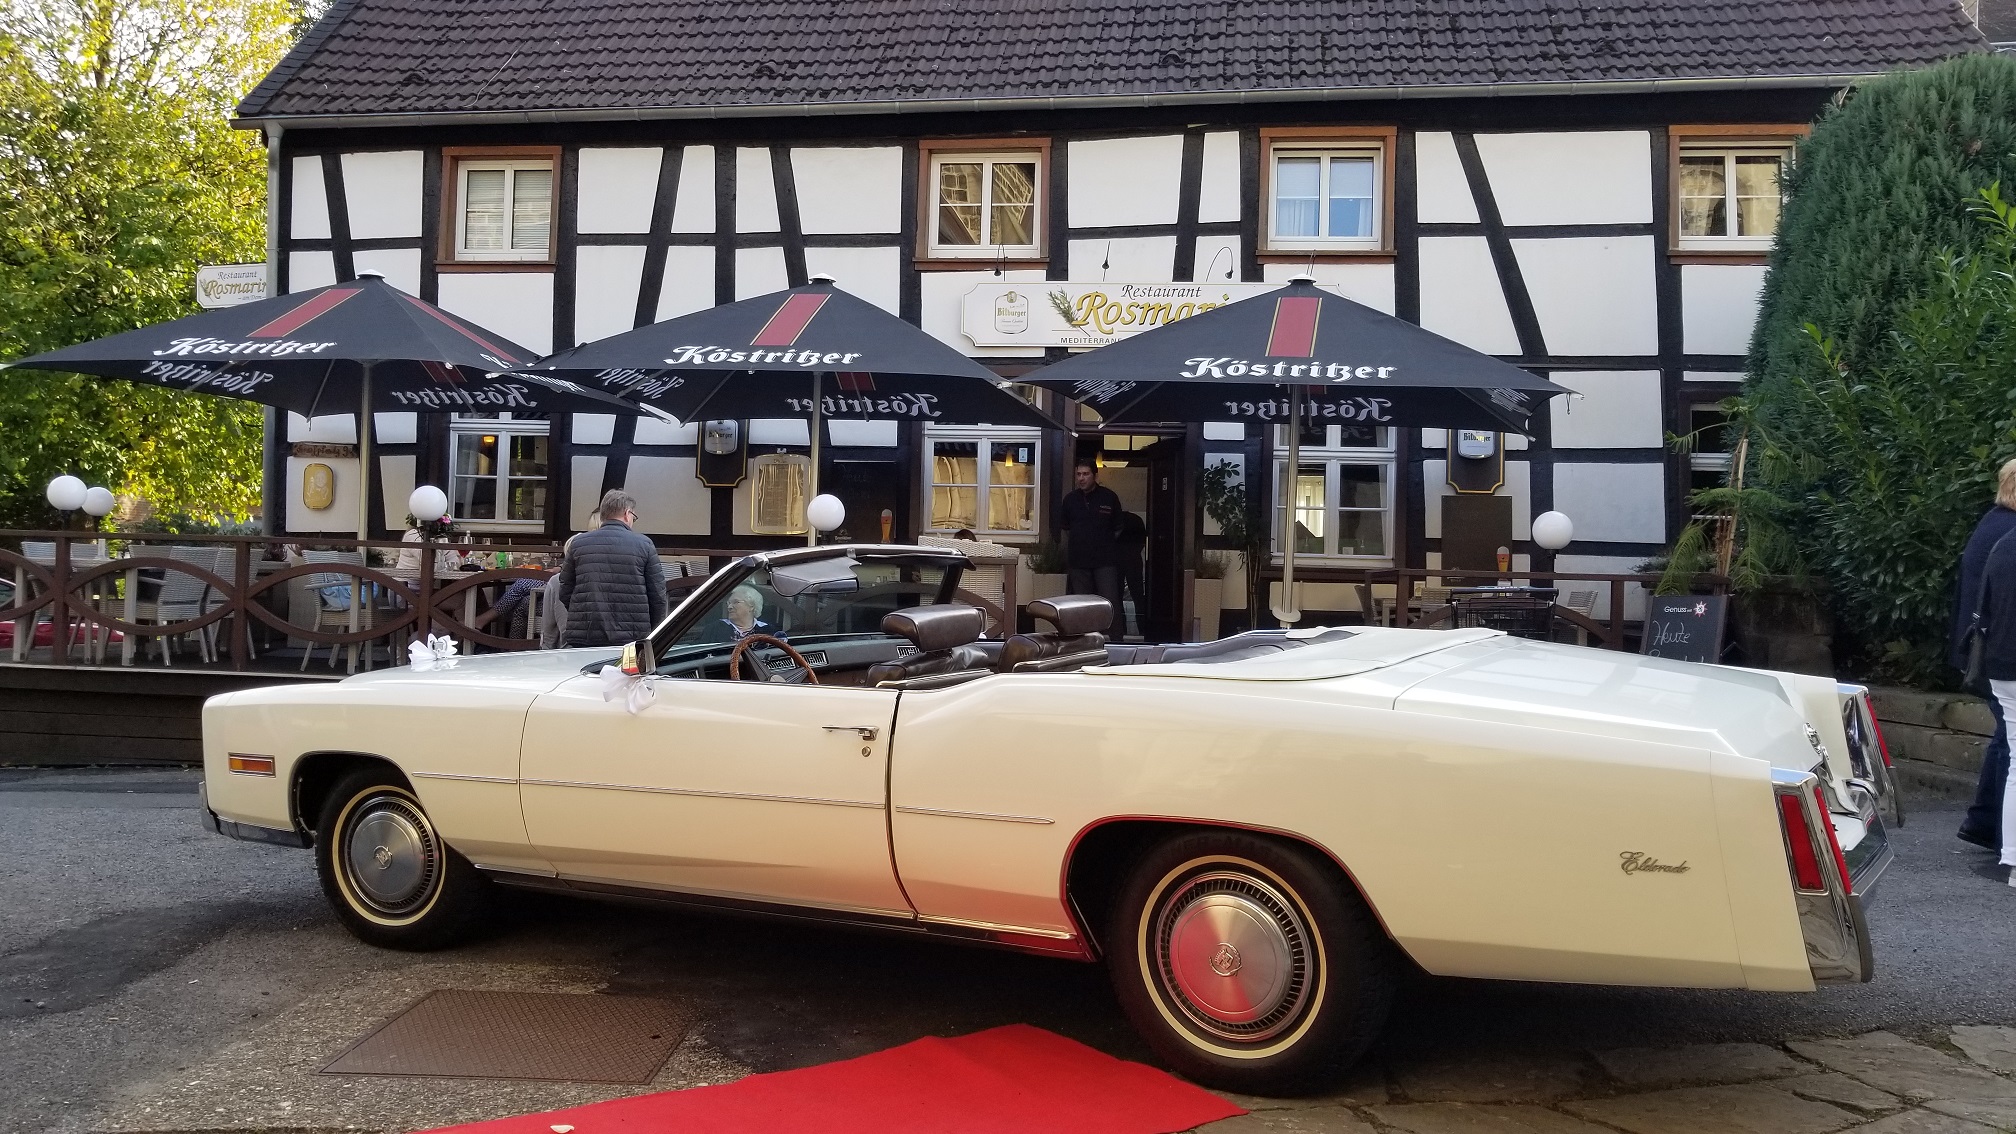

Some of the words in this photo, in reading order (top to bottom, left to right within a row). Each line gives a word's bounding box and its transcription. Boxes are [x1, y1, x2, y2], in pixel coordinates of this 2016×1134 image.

[218, 271, 257, 280] Restaurant
[1121, 284, 1202, 300] Restaurant
[153, 337, 338, 357] Köstritzer
[663, 345, 862, 367] Köstritzer
[1179, 357, 1398, 382] Köstritzer
[1664, 605, 1687, 613] Genuss
[1652, 619, 1691, 646] Heute
[1619, 851, 1691, 876] Eldorado
